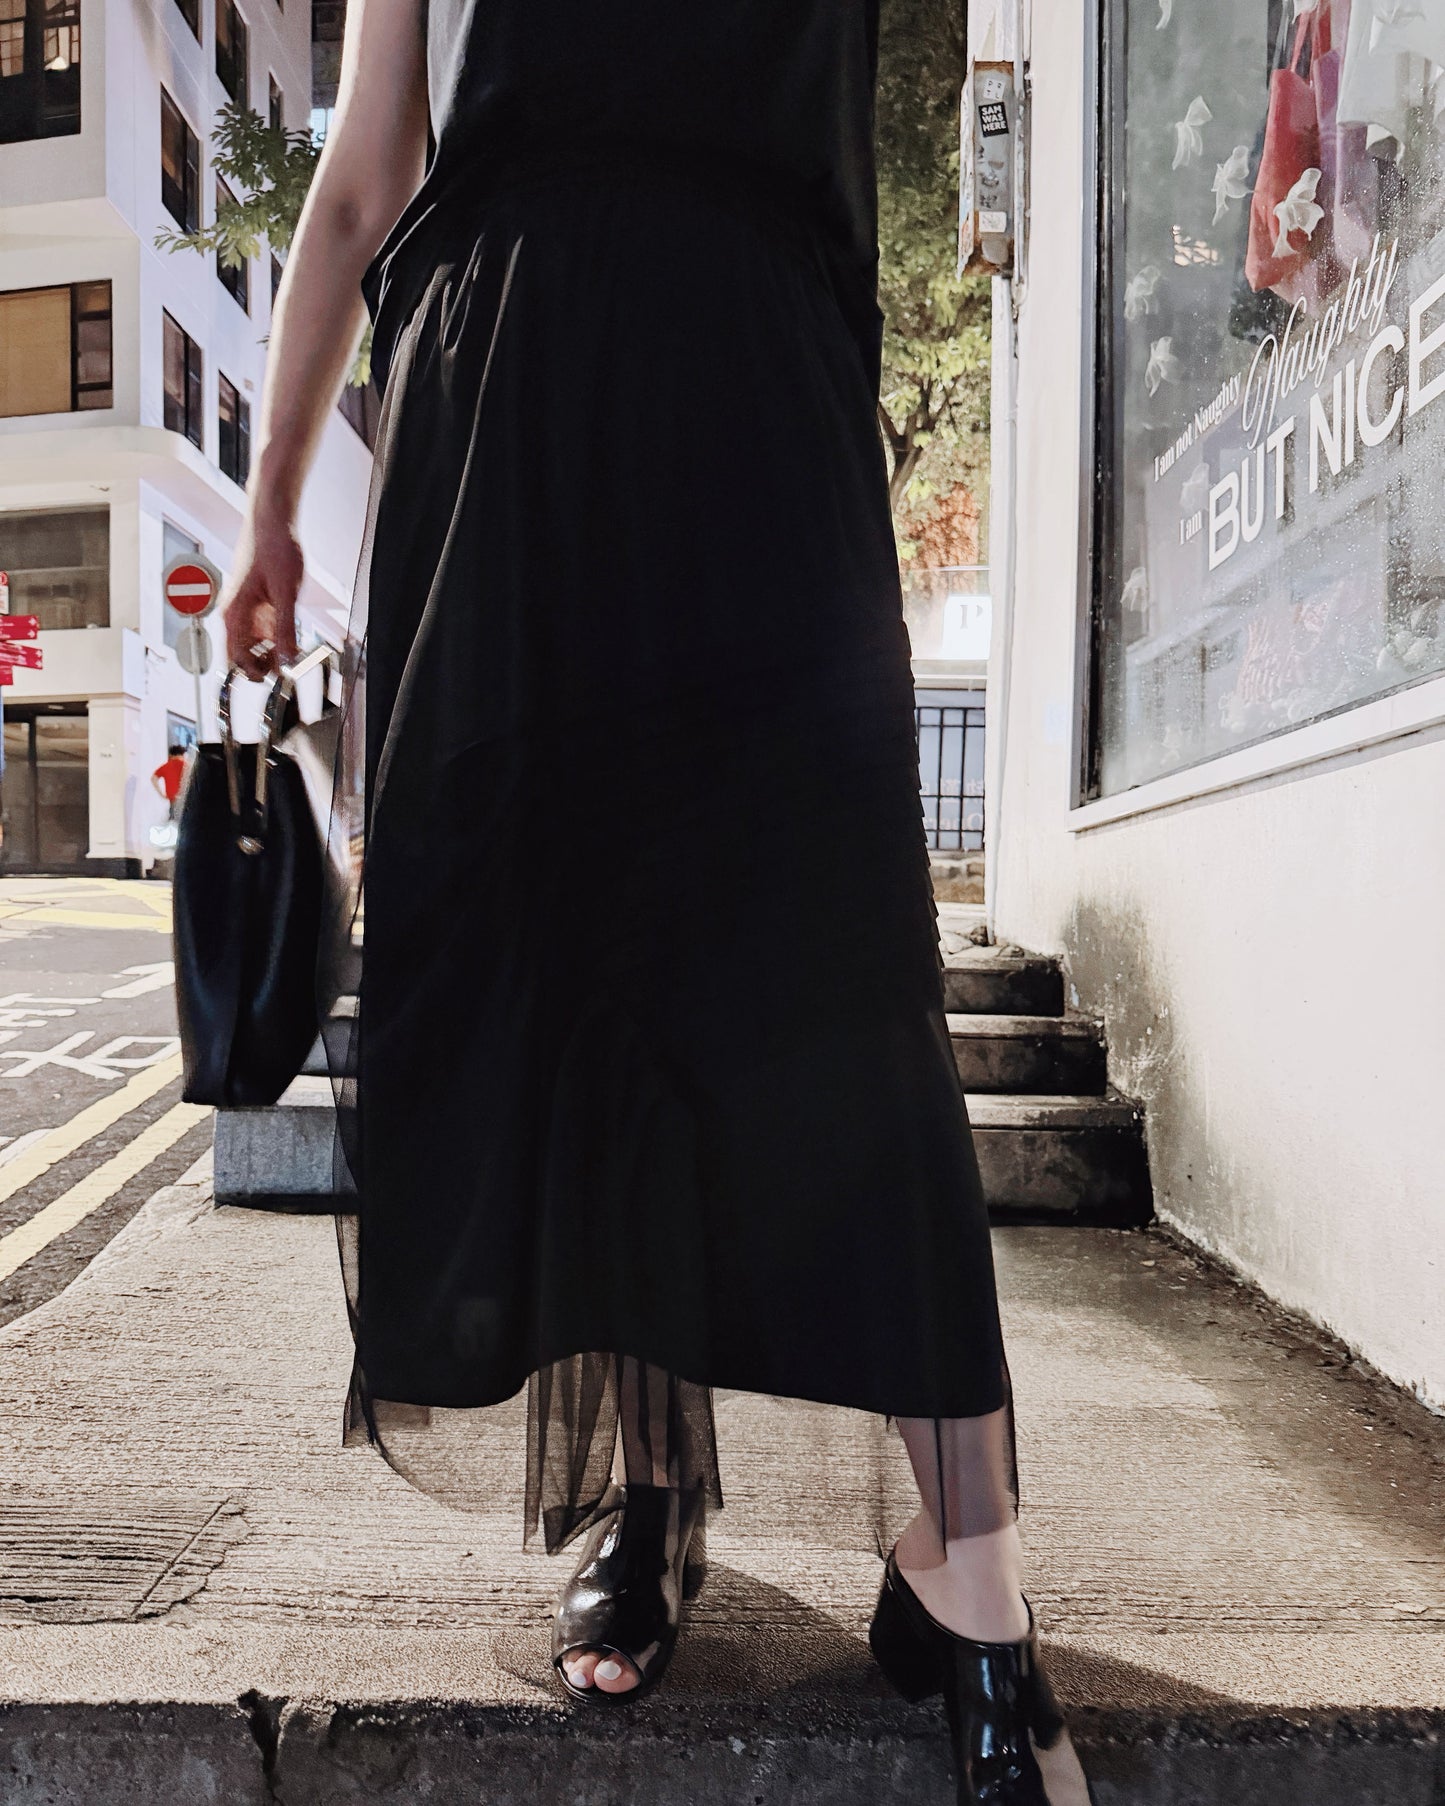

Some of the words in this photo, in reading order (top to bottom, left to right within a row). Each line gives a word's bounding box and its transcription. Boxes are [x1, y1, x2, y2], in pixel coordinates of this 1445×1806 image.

[981, 104, 1002, 116] SAM
[982, 112, 1004, 124] WAS
[983, 121, 1007, 132] HERE
[1154, 456, 1160, 482] I
[1160, 446, 1174, 477] am
[1176, 422, 1193, 460] not
[1194, 371, 1242, 441] Naughty
[1242, 232, 1400, 450] Naughty
[1179, 518, 1185, 545] I
[1185, 510, 1202, 541] am
[1209, 415, 1296, 571] BUT
[1309, 272, 1445, 494] NICE
